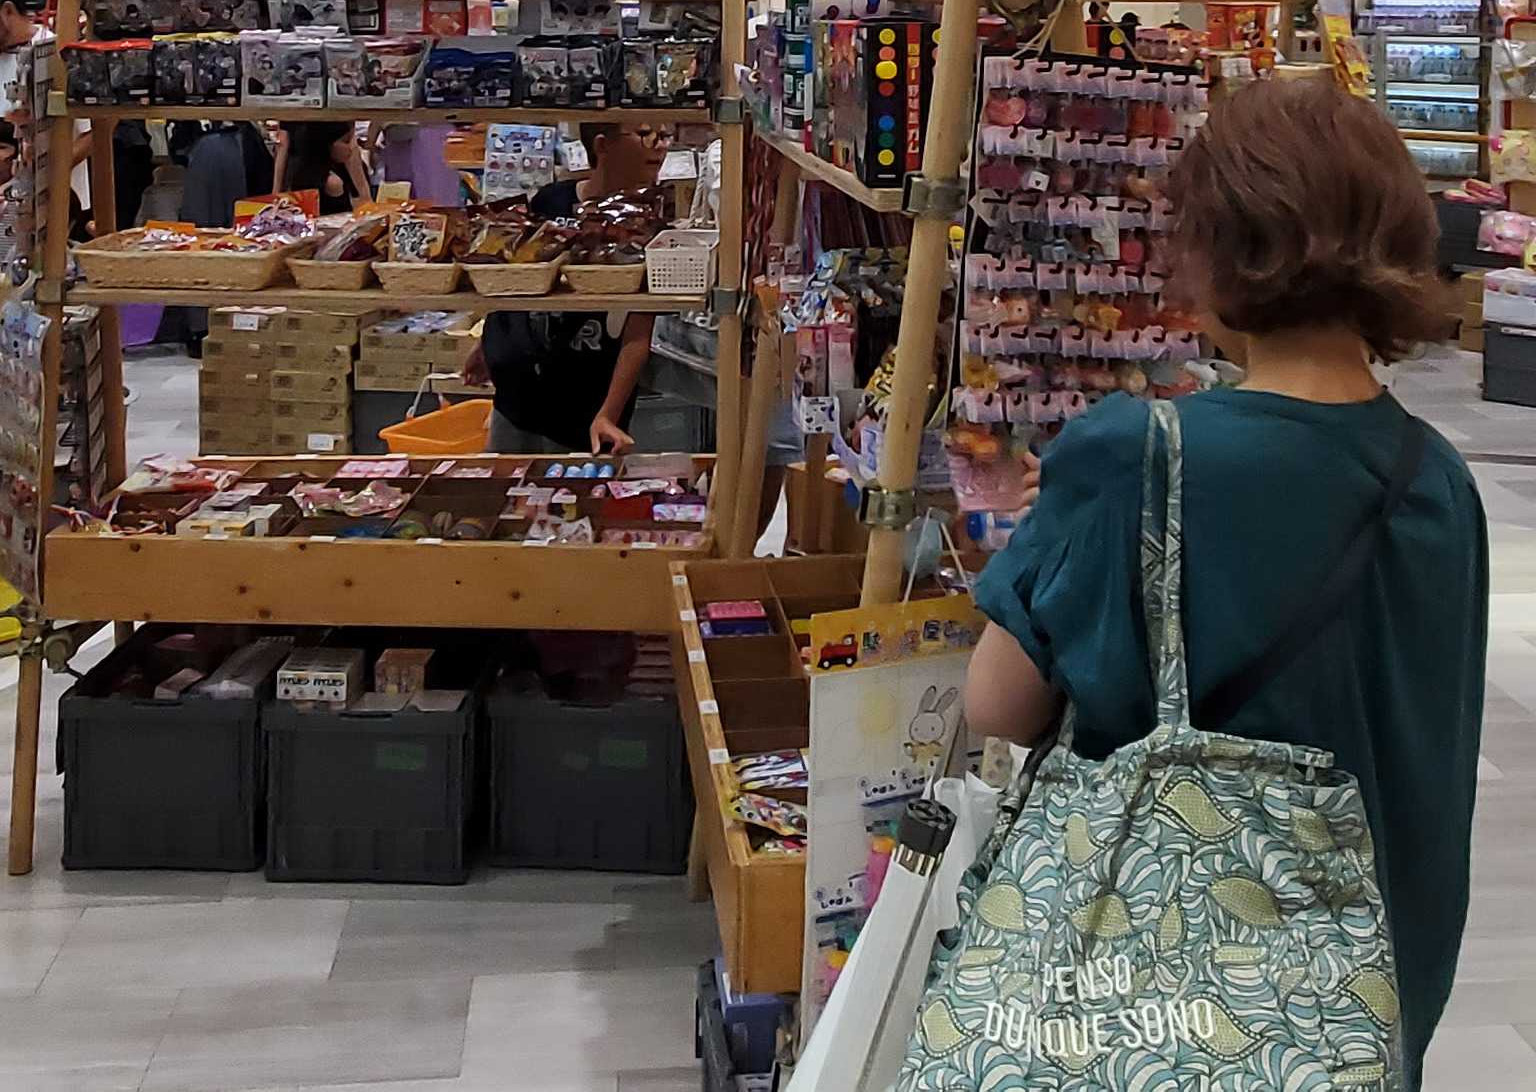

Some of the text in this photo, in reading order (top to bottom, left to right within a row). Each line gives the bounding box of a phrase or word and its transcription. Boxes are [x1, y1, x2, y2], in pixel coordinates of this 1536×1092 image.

[1042, 954, 1131, 1004] PENSO
[983, 998, 1214, 1059] DUNQUE SONO
